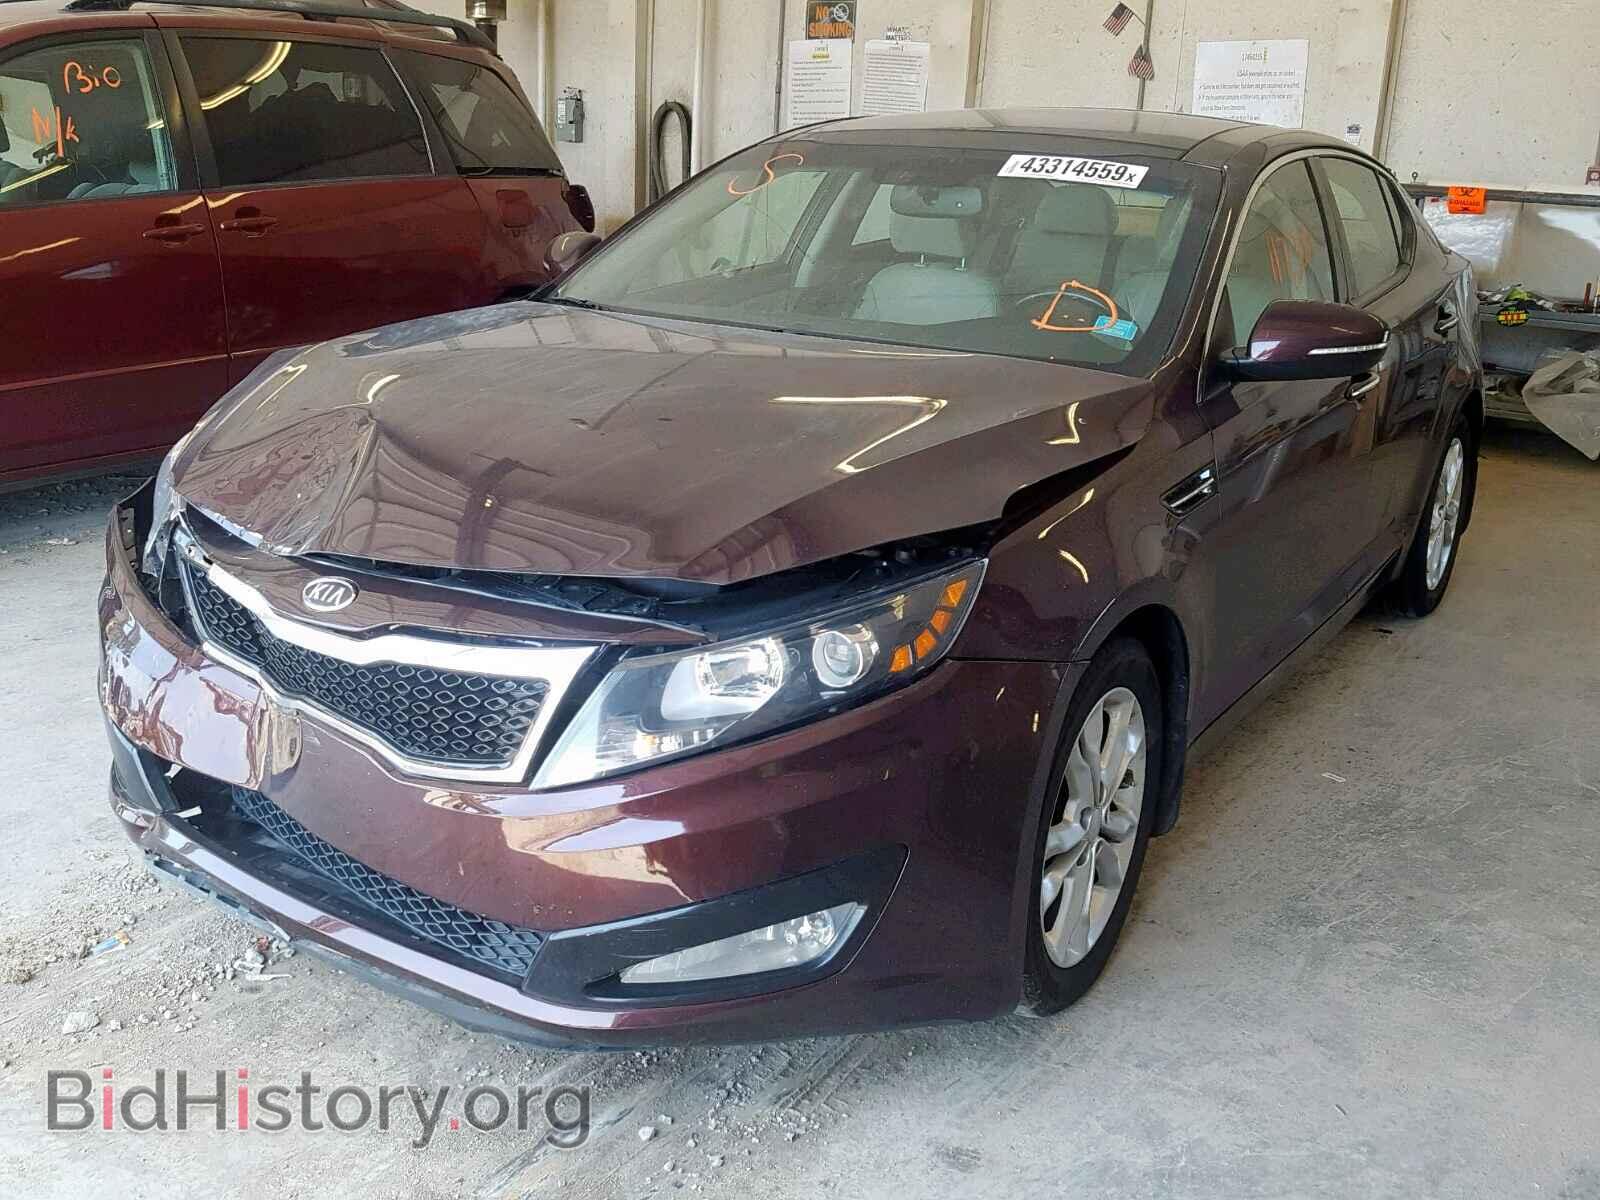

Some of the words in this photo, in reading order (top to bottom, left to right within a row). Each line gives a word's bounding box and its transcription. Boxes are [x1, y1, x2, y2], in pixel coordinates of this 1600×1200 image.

[816, 5, 829, 20] NO
[809, 21, 853, 38] SMOKING
[308, 582, 346, 606] KIA
